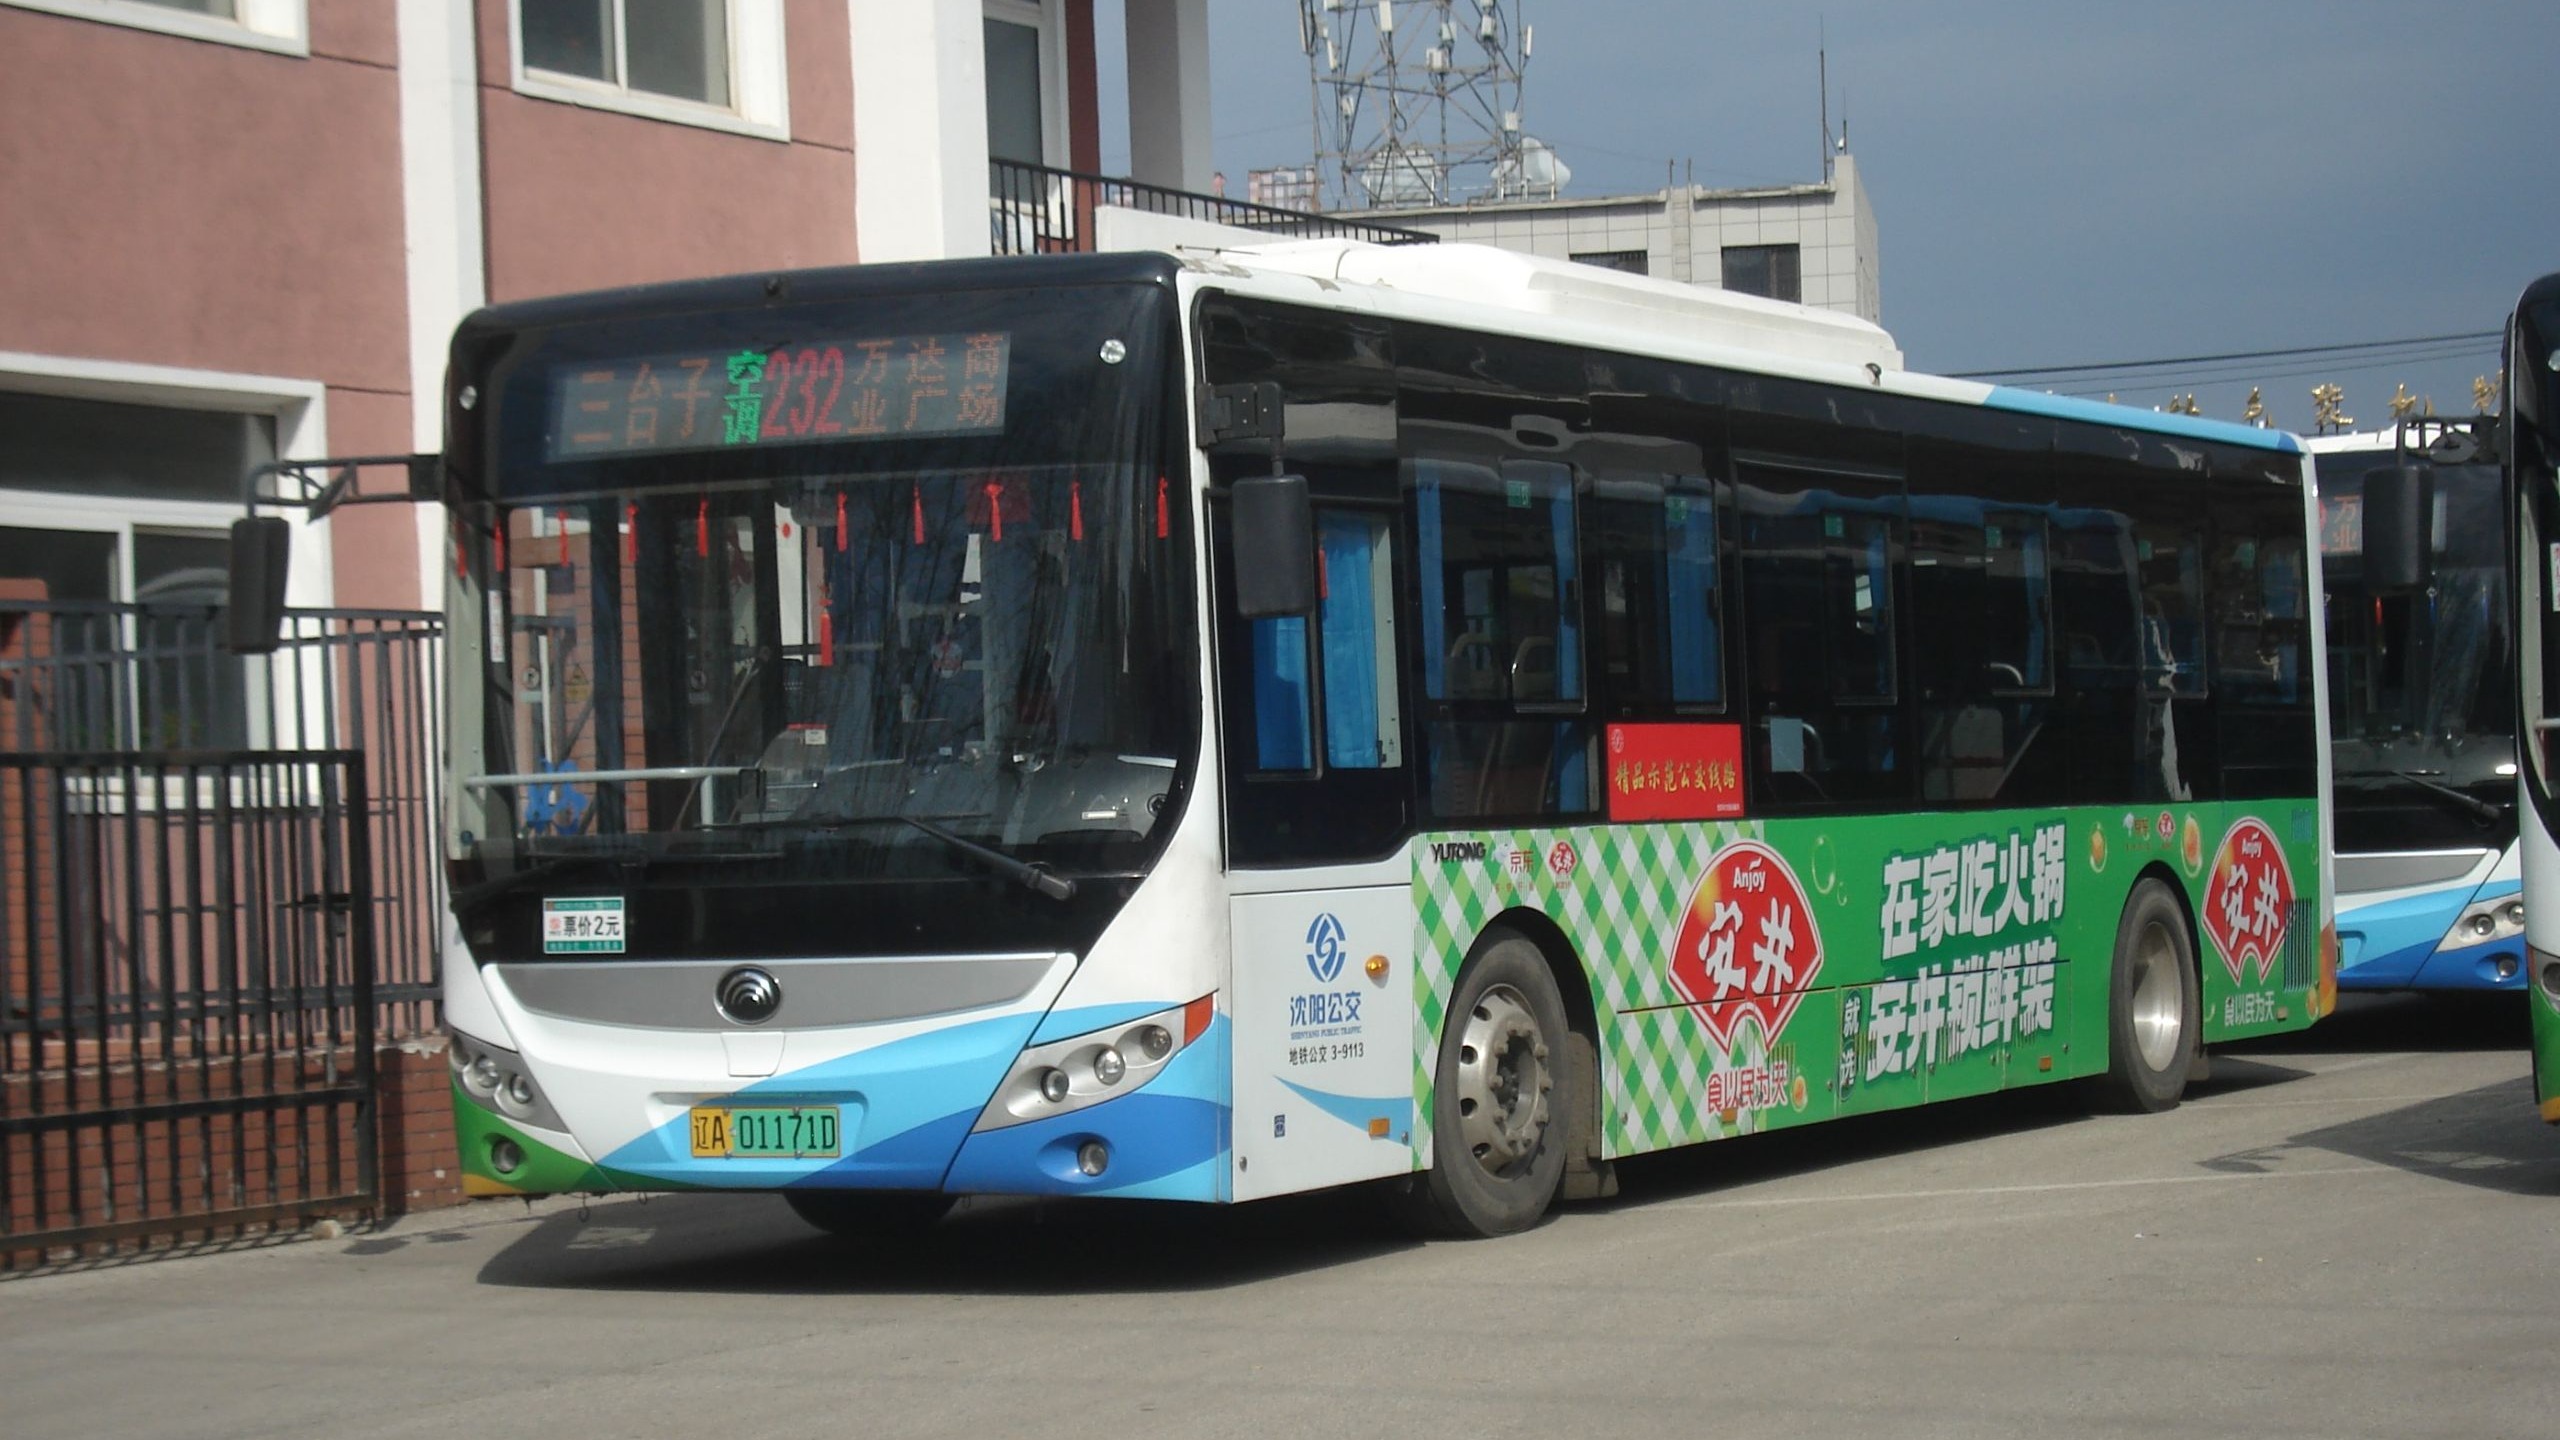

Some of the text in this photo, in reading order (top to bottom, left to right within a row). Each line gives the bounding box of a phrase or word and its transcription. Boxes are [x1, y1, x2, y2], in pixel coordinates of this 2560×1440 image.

[853, 334, 1003, 385] 万达商
[574, 346, 844, 446] 三台子 空调 232
[848, 382, 999, 434] 业广场
[1614, 758, 1736, 795] 精品示范公交线路
[1431, 841, 1486, 864] YUTONG
[1732, 857, 1767, 893] Anjoy
[1880, 823, 2066, 960] 在家吃火锅
[2220, 862, 2280, 950] 安井
[563, 915, 620, 937] 票价2元
[1698, 897, 1794, 1015] 安井
[1290, 991, 1361, 1027] 沈阳公交
[1866, 936, 2057, 1082] 安井锁鲜装
[1289, 1042, 1364, 1065] 地铁公交 3-9113
[1707, 1062, 1788, 1115] 食以民为天
[694, 1115, 836, 1150] 辽A 01171D
